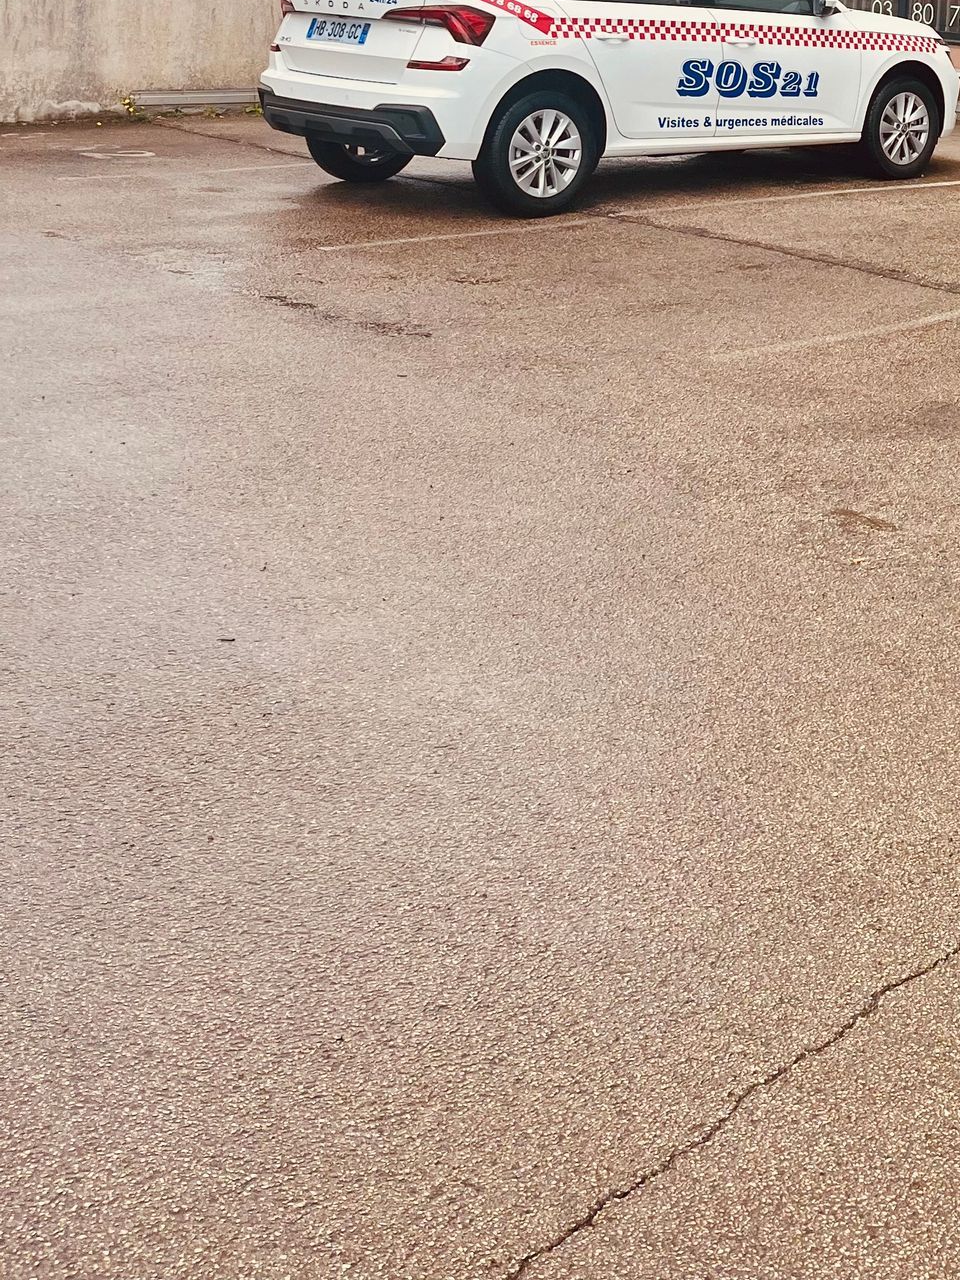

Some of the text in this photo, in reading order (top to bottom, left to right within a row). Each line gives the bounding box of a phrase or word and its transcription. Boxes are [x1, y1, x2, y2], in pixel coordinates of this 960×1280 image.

[507, 1, 522, 14] 68
[524, 8, 539, 23] 68
[911, 2, 934, 24] 80
[676, 58, 820, 98] SOS 21
[658, 115, 824, 130] Visites & urgences médicales
